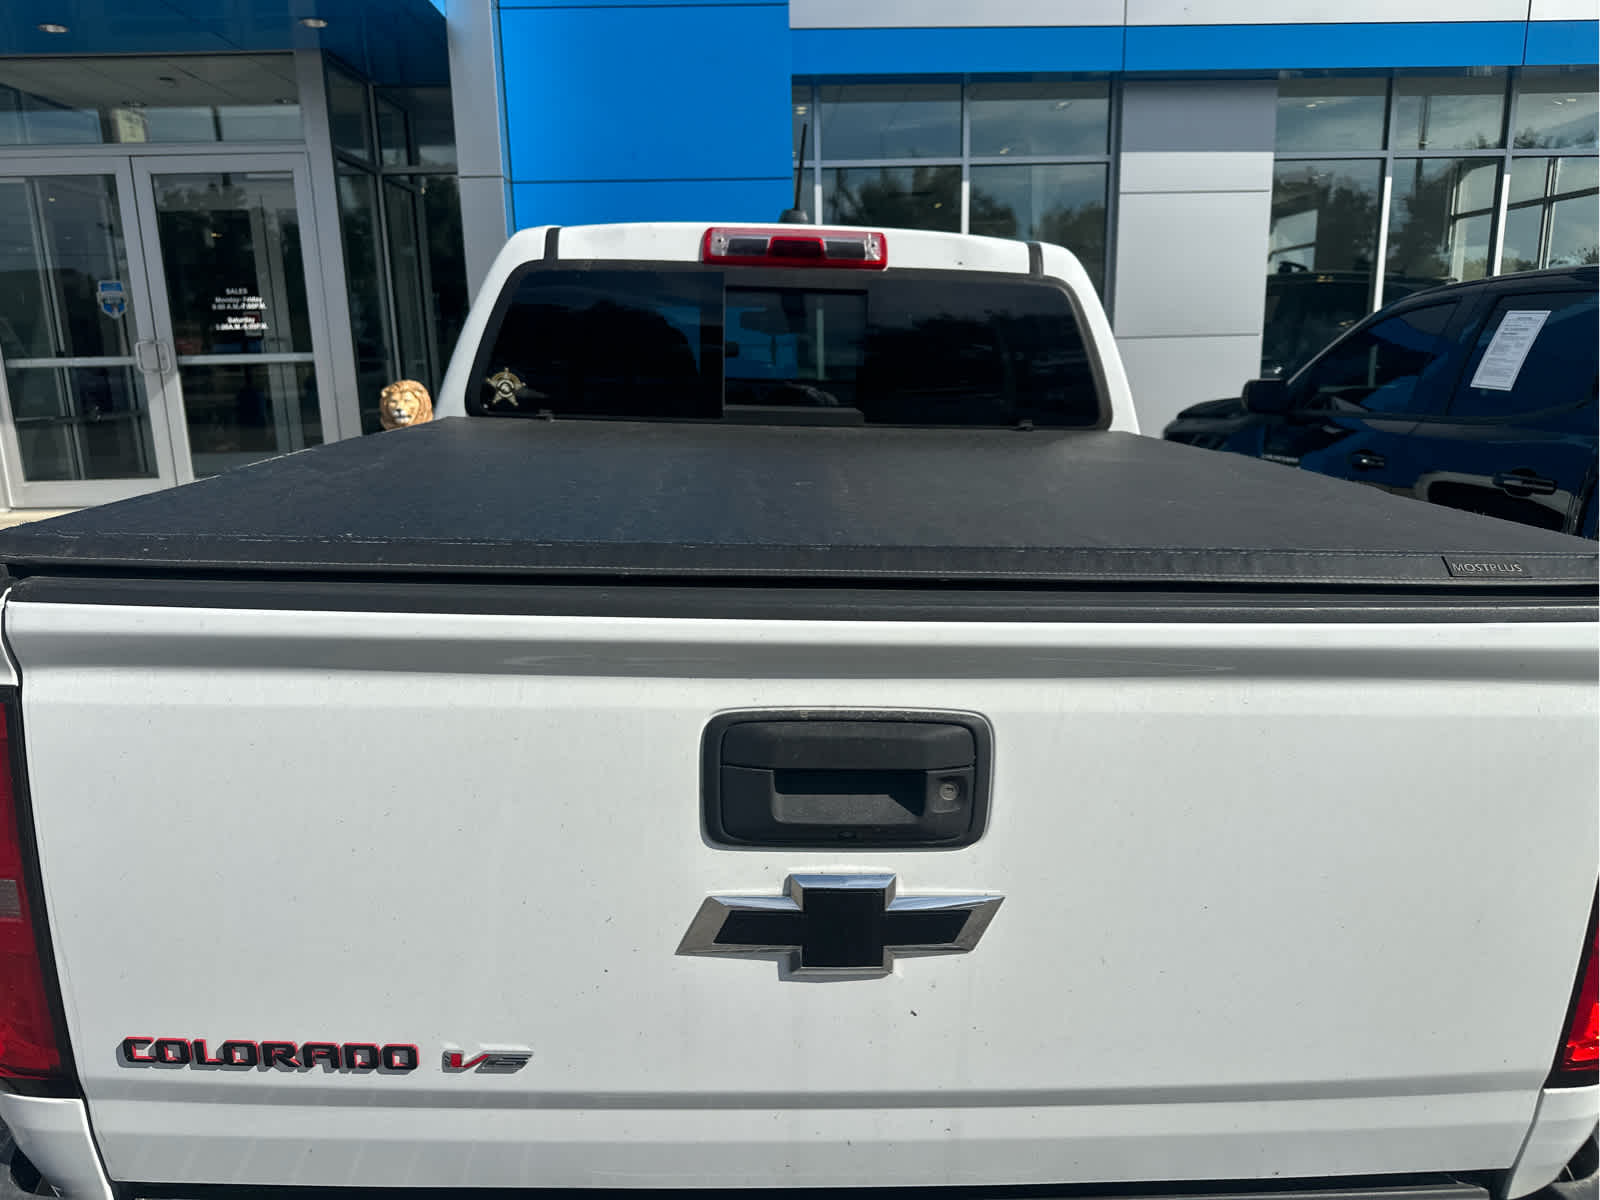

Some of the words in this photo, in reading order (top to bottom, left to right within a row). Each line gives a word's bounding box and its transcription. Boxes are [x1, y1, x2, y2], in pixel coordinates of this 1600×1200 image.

[1451, 563, 1522, 572] MOSTPLUS
[117, 1036, 420, 1074] COLORADO
[441, 1049, 534, 1074] V6
